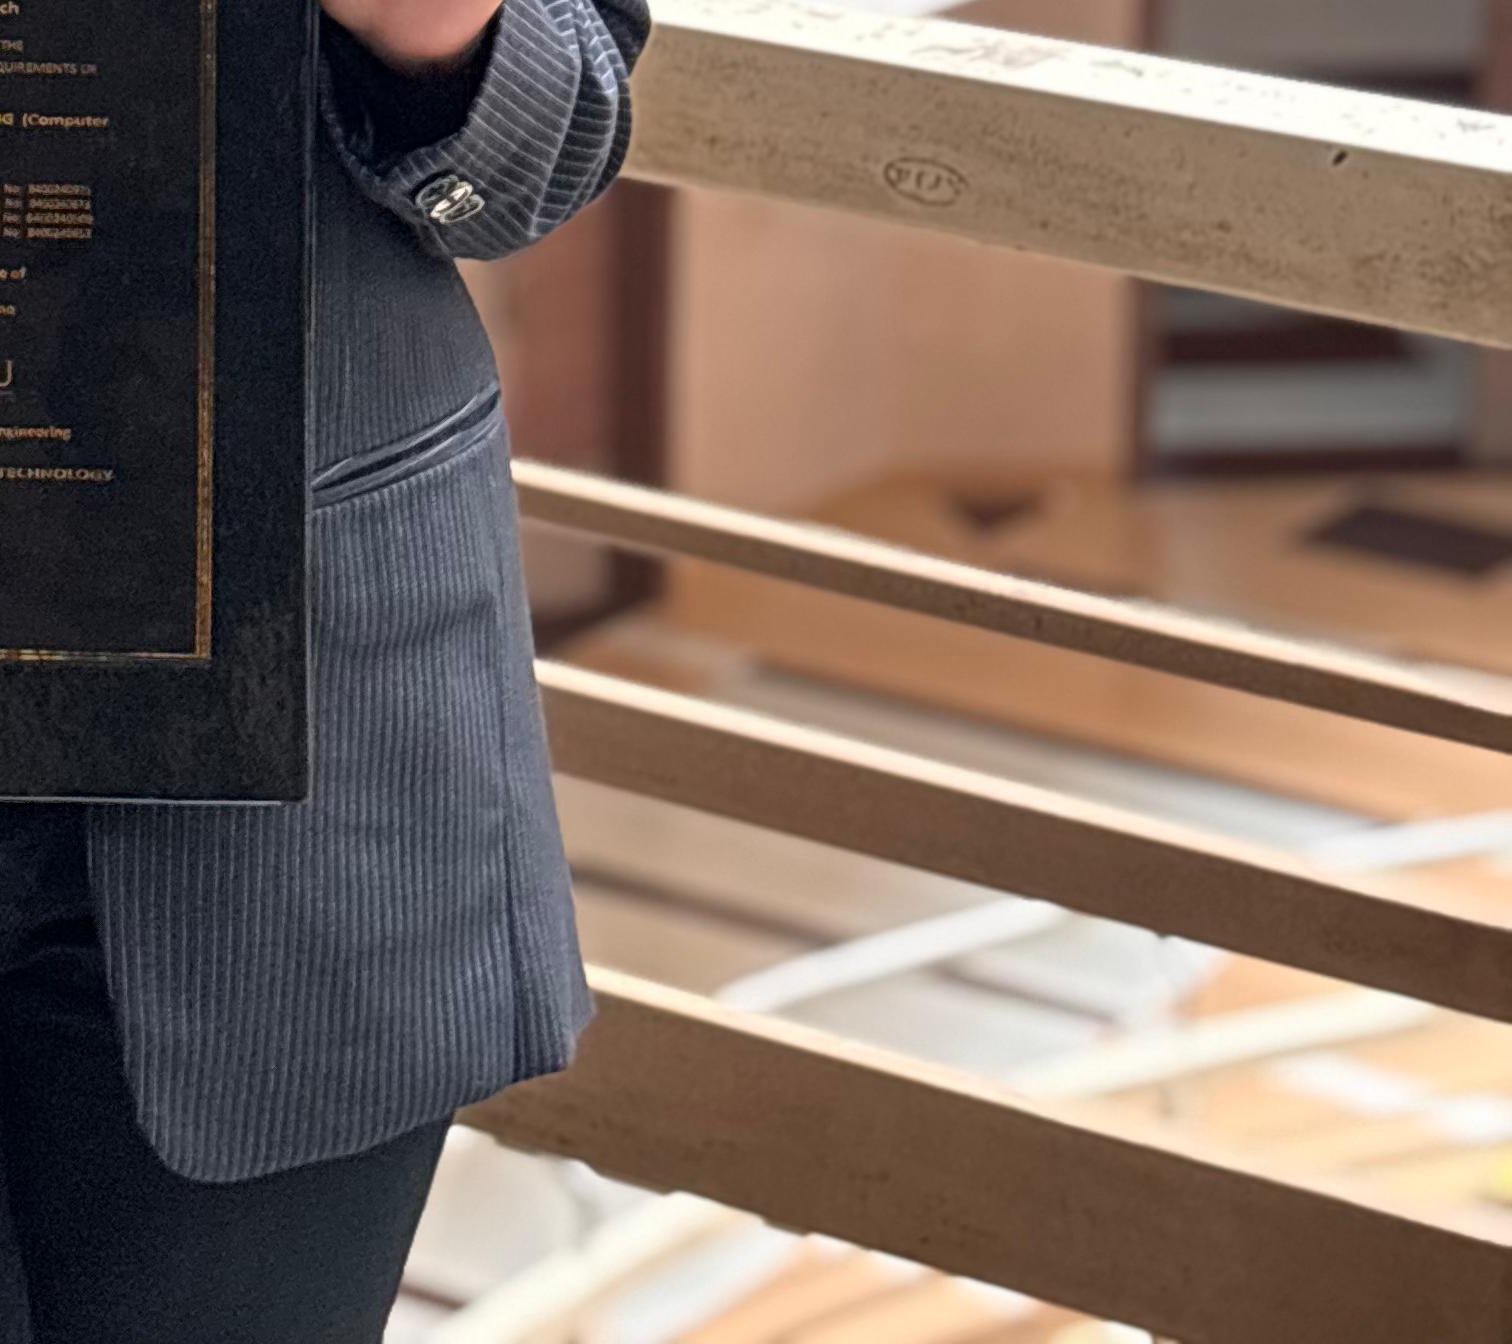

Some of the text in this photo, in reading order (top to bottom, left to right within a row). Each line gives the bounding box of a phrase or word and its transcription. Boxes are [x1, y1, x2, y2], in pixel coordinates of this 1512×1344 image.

[0, 39, 24, 52] THE
[21, 112, 110, 129] (Computer
[10, 266, 27, 279] of
